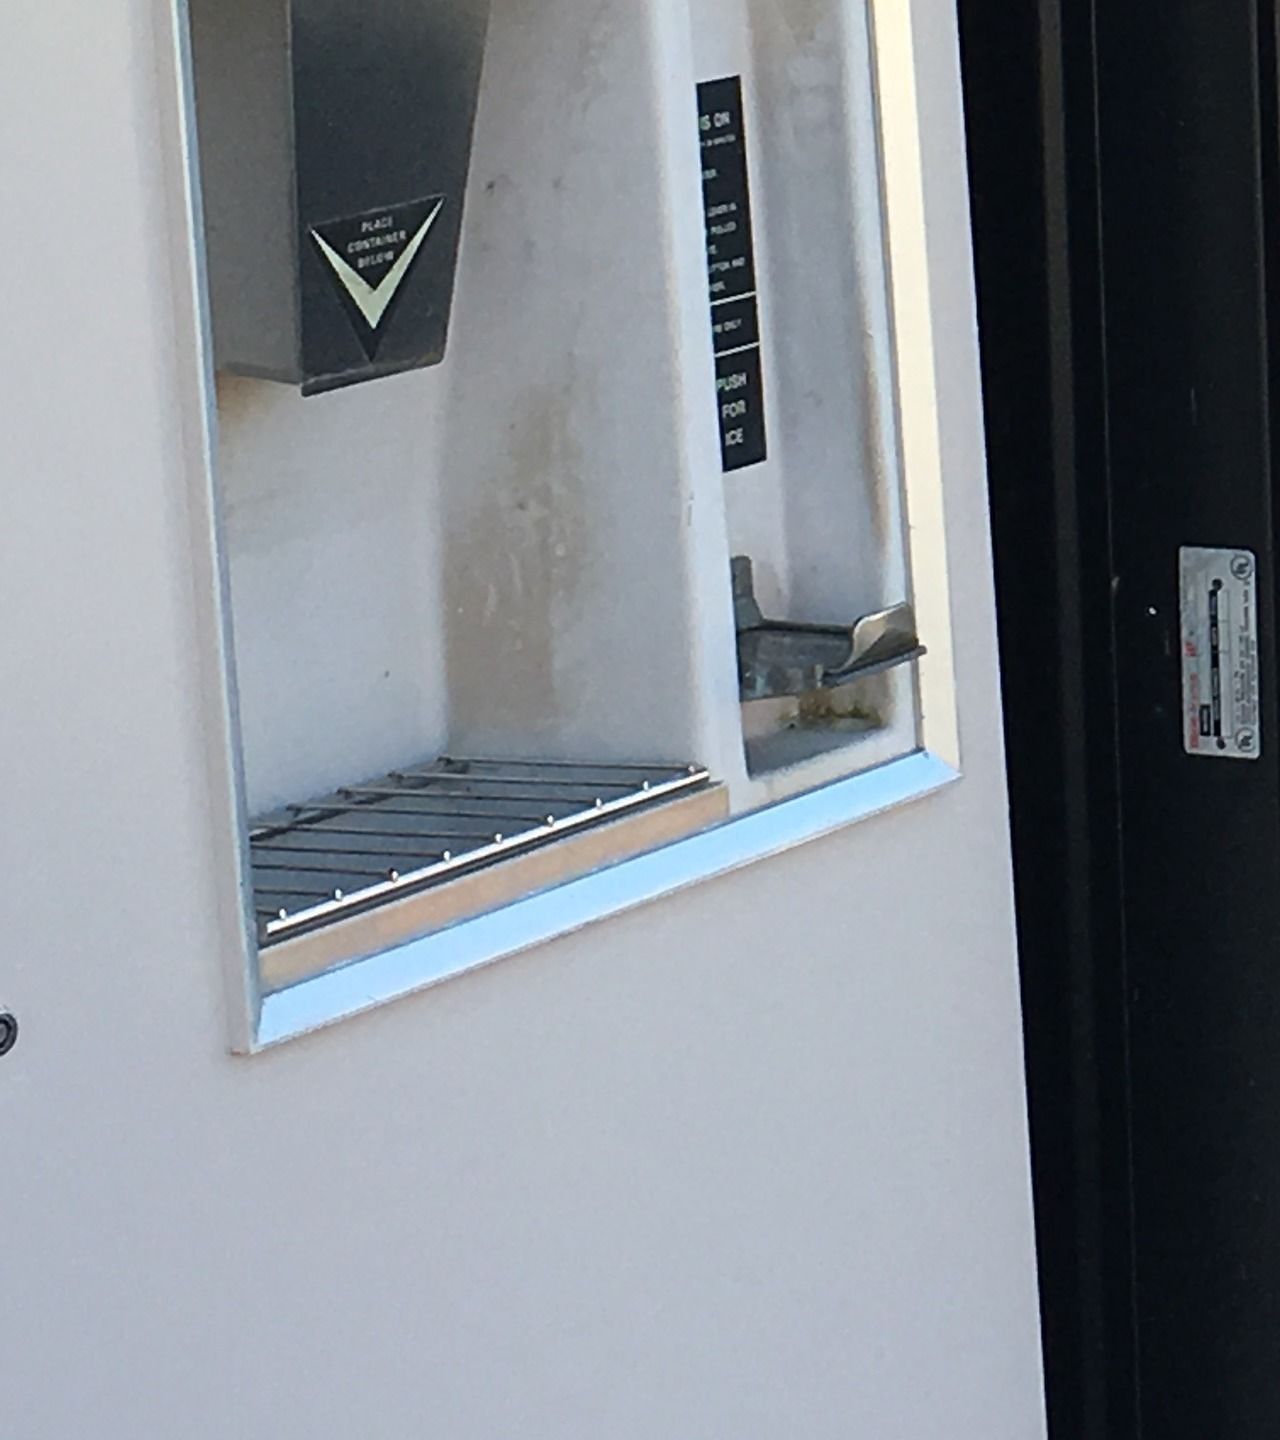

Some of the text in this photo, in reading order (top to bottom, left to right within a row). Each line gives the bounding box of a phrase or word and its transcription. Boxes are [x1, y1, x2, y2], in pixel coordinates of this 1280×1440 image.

[347, 229, 406, 254] CONTAINER
[716, 372, 747, 392] PUSH
[722, 399, 746, 418] FOR
[725, 427, 744, 446] ICE
